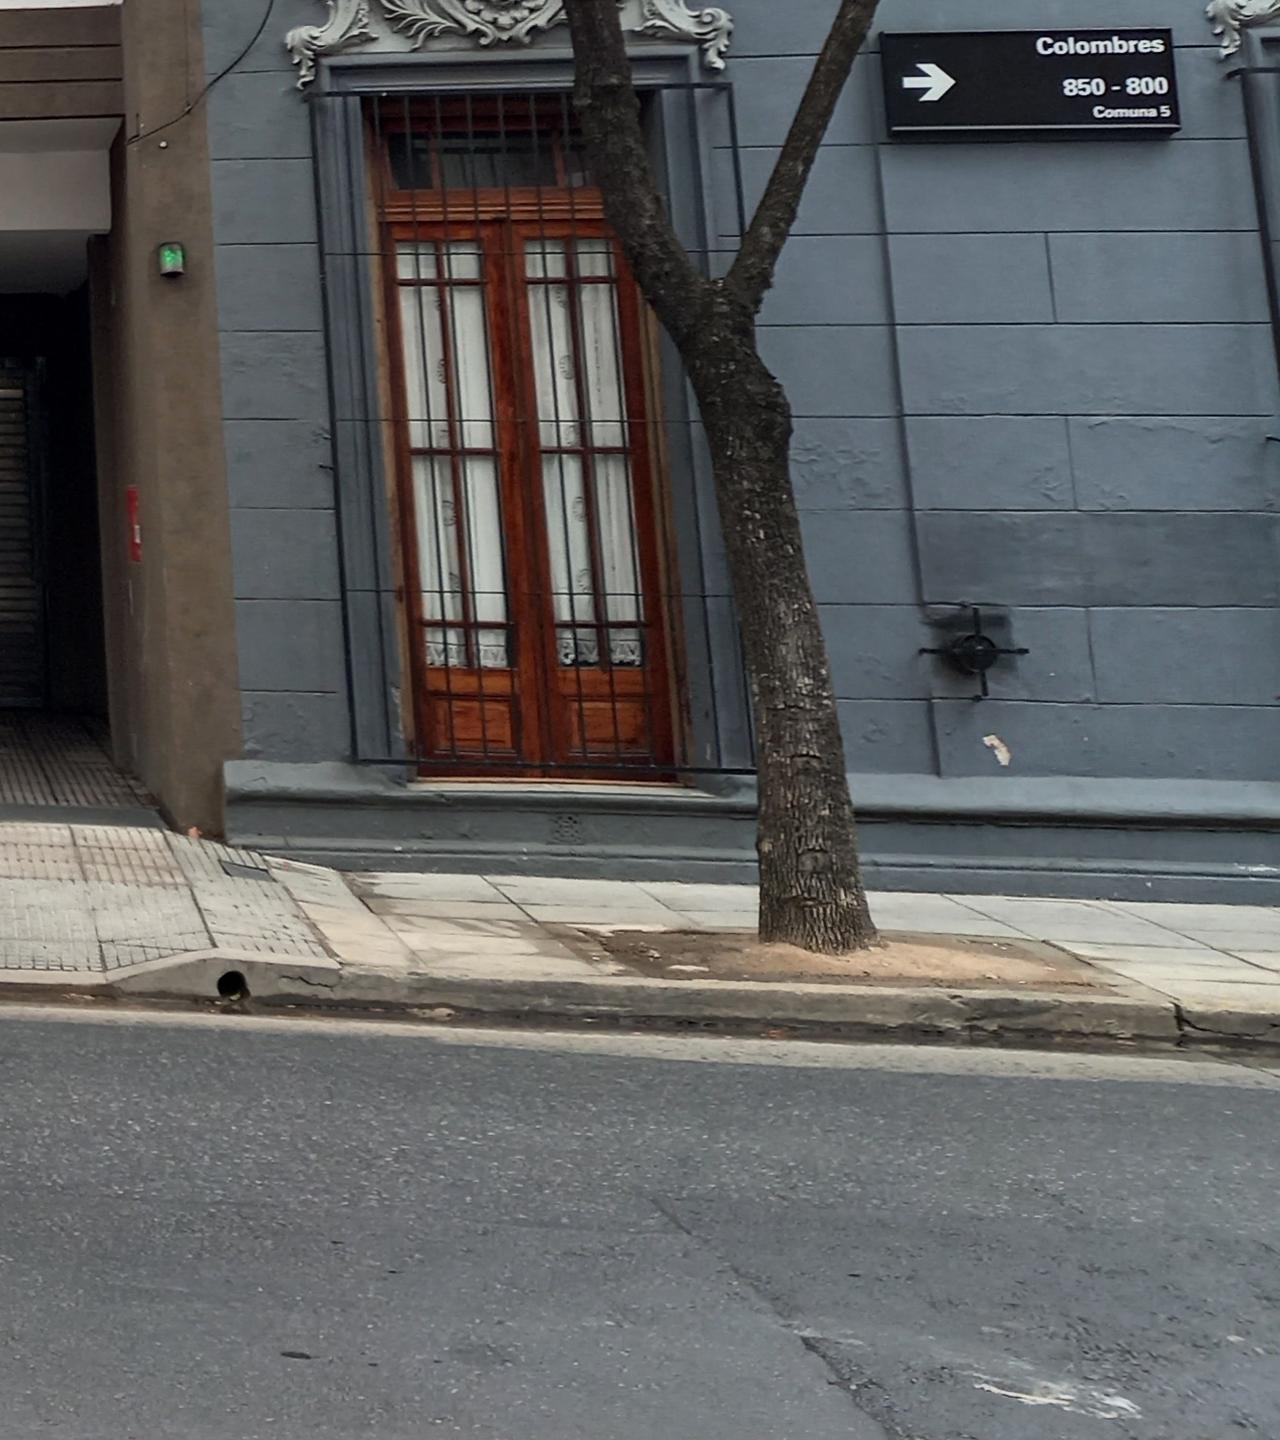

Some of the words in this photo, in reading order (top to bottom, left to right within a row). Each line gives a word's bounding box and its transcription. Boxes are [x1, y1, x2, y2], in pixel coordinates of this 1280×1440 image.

[1036, 36, 1165, 55] Colombres
[1062, 78, 1106, 96] 850
[1125, 77, 1169, 95] 800
[1092, 105, 1158, 118] Comuna
[1159, 105, 1171, 117] 5
